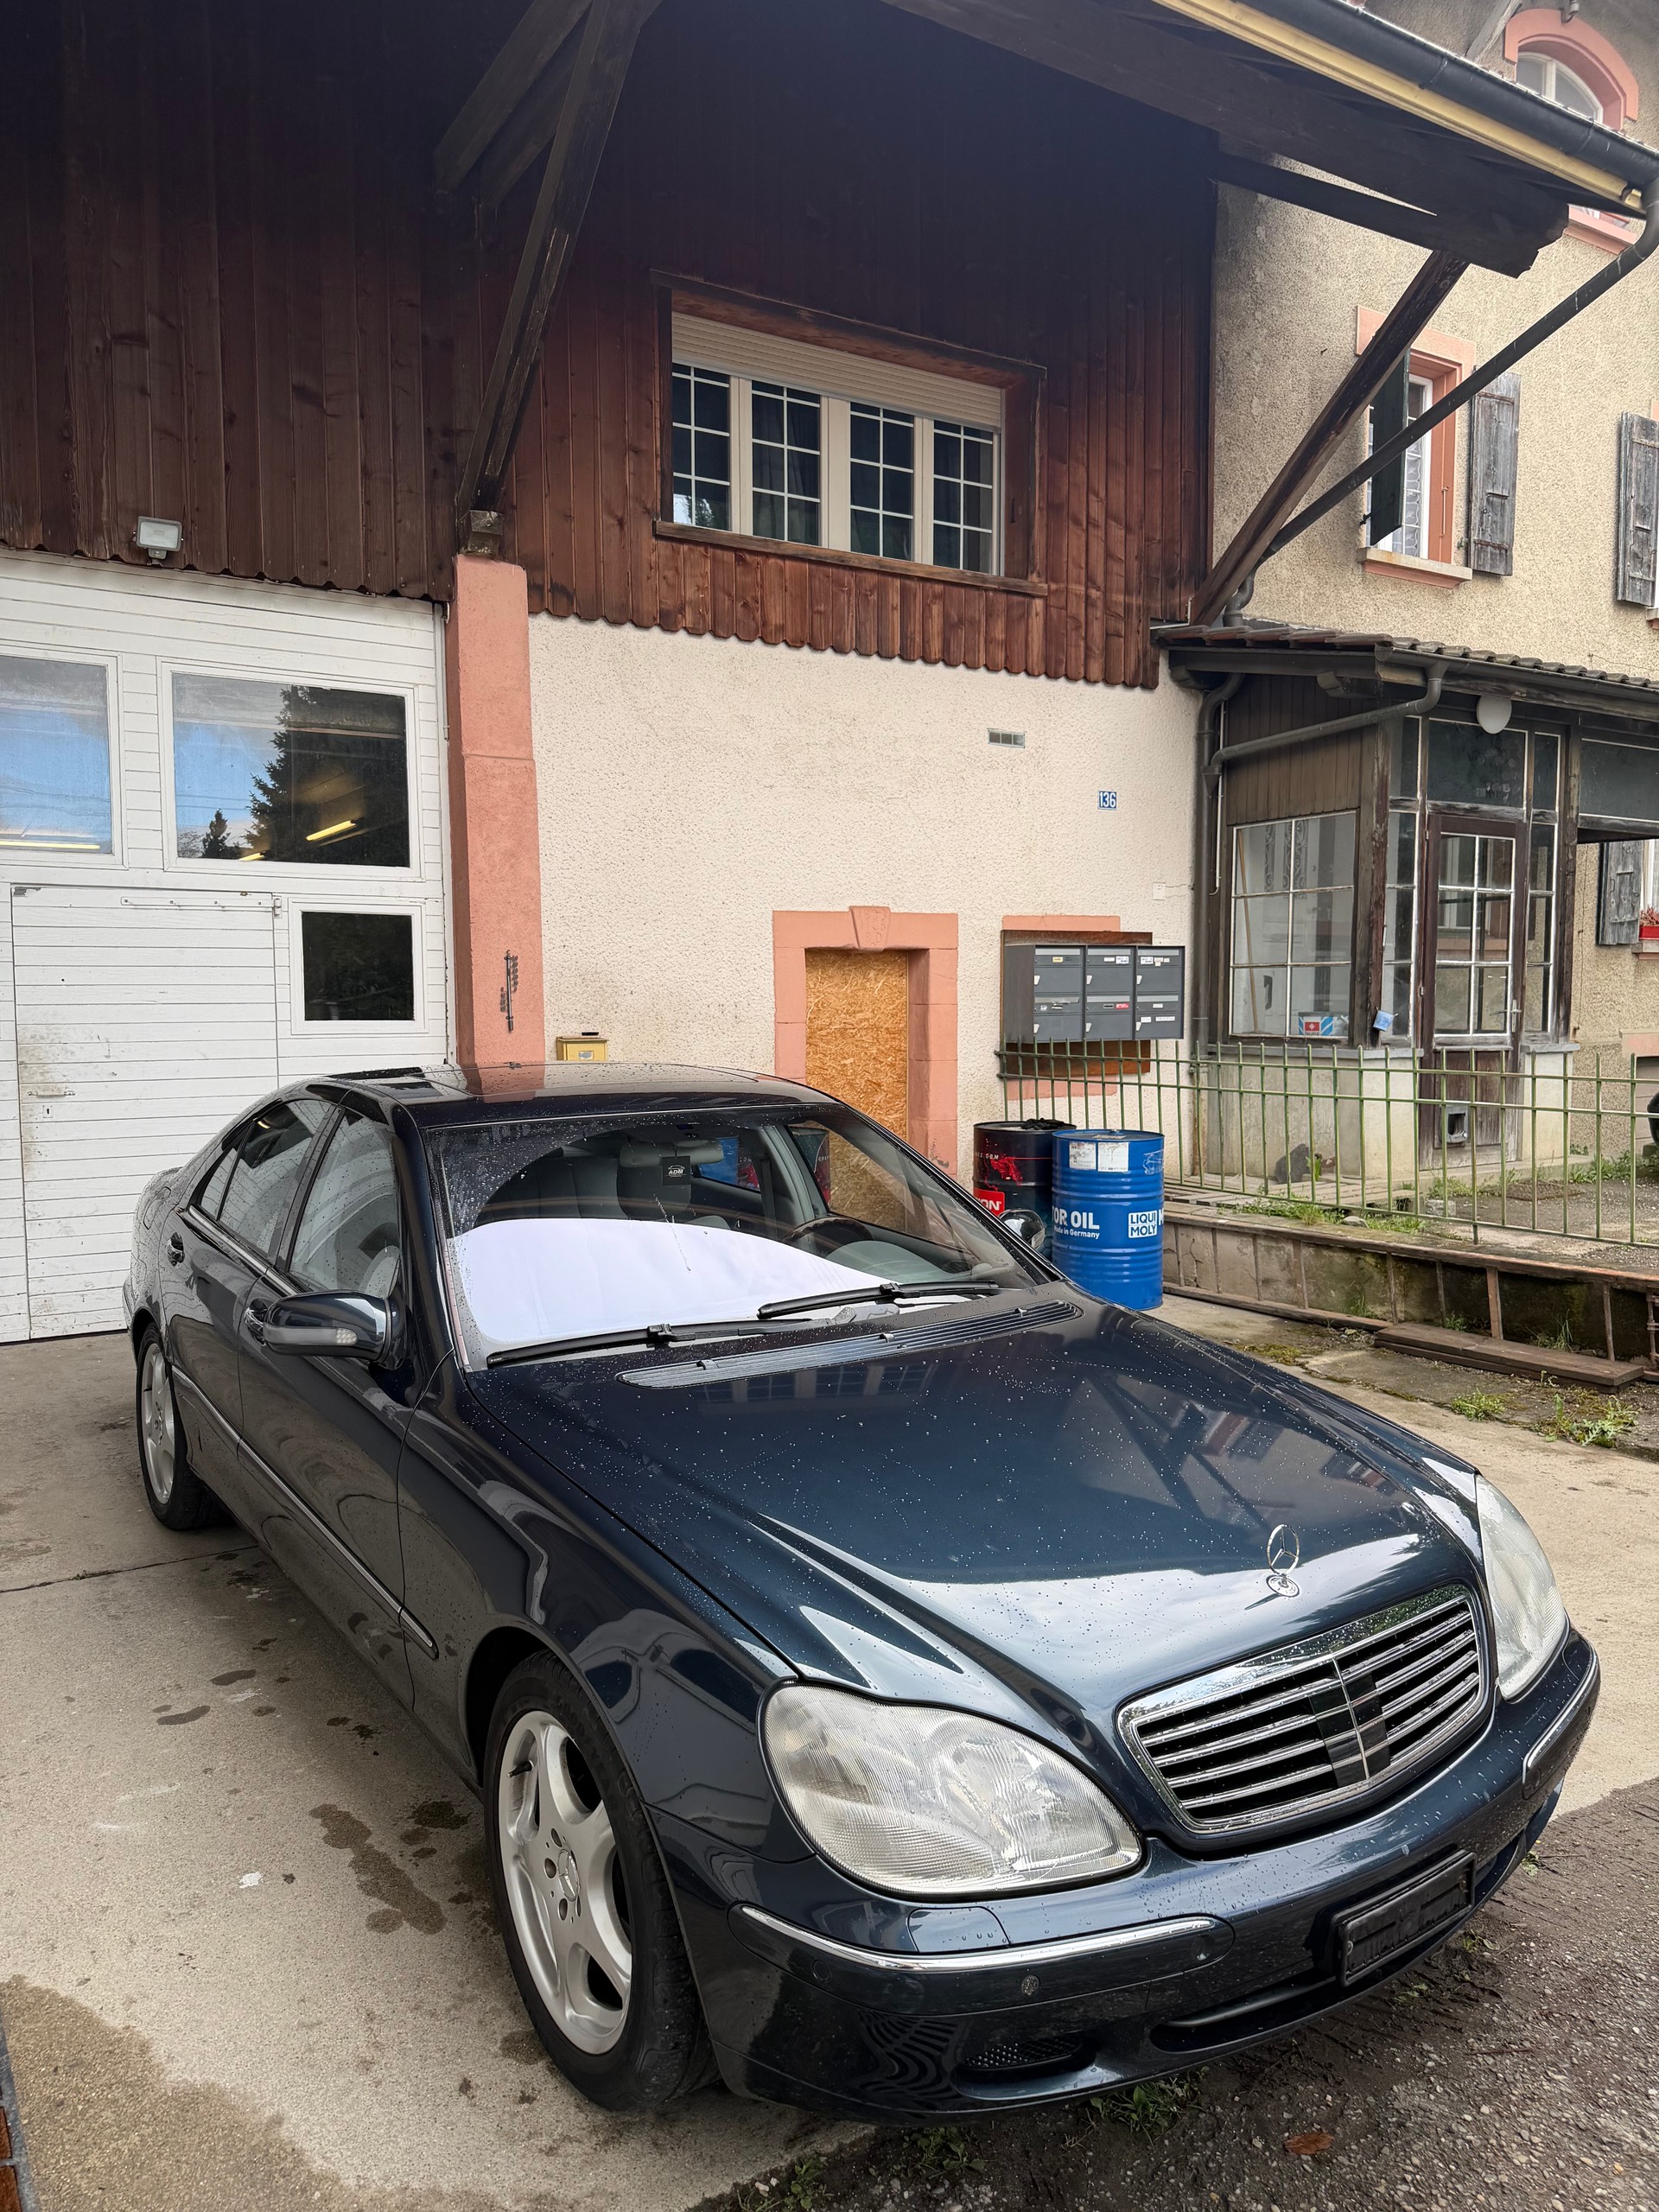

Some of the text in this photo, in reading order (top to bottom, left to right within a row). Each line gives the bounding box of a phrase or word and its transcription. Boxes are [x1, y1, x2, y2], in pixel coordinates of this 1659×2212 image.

[1100, 791, 1116, 808] 136
[1071, 1211, 1100, 1230] OIL
[1130, 1211, 1156, 1224] LIQUI
[1070, 1229, 1100, 1239] Germany
[1130, 1224, 1156, 1236] MOLY
